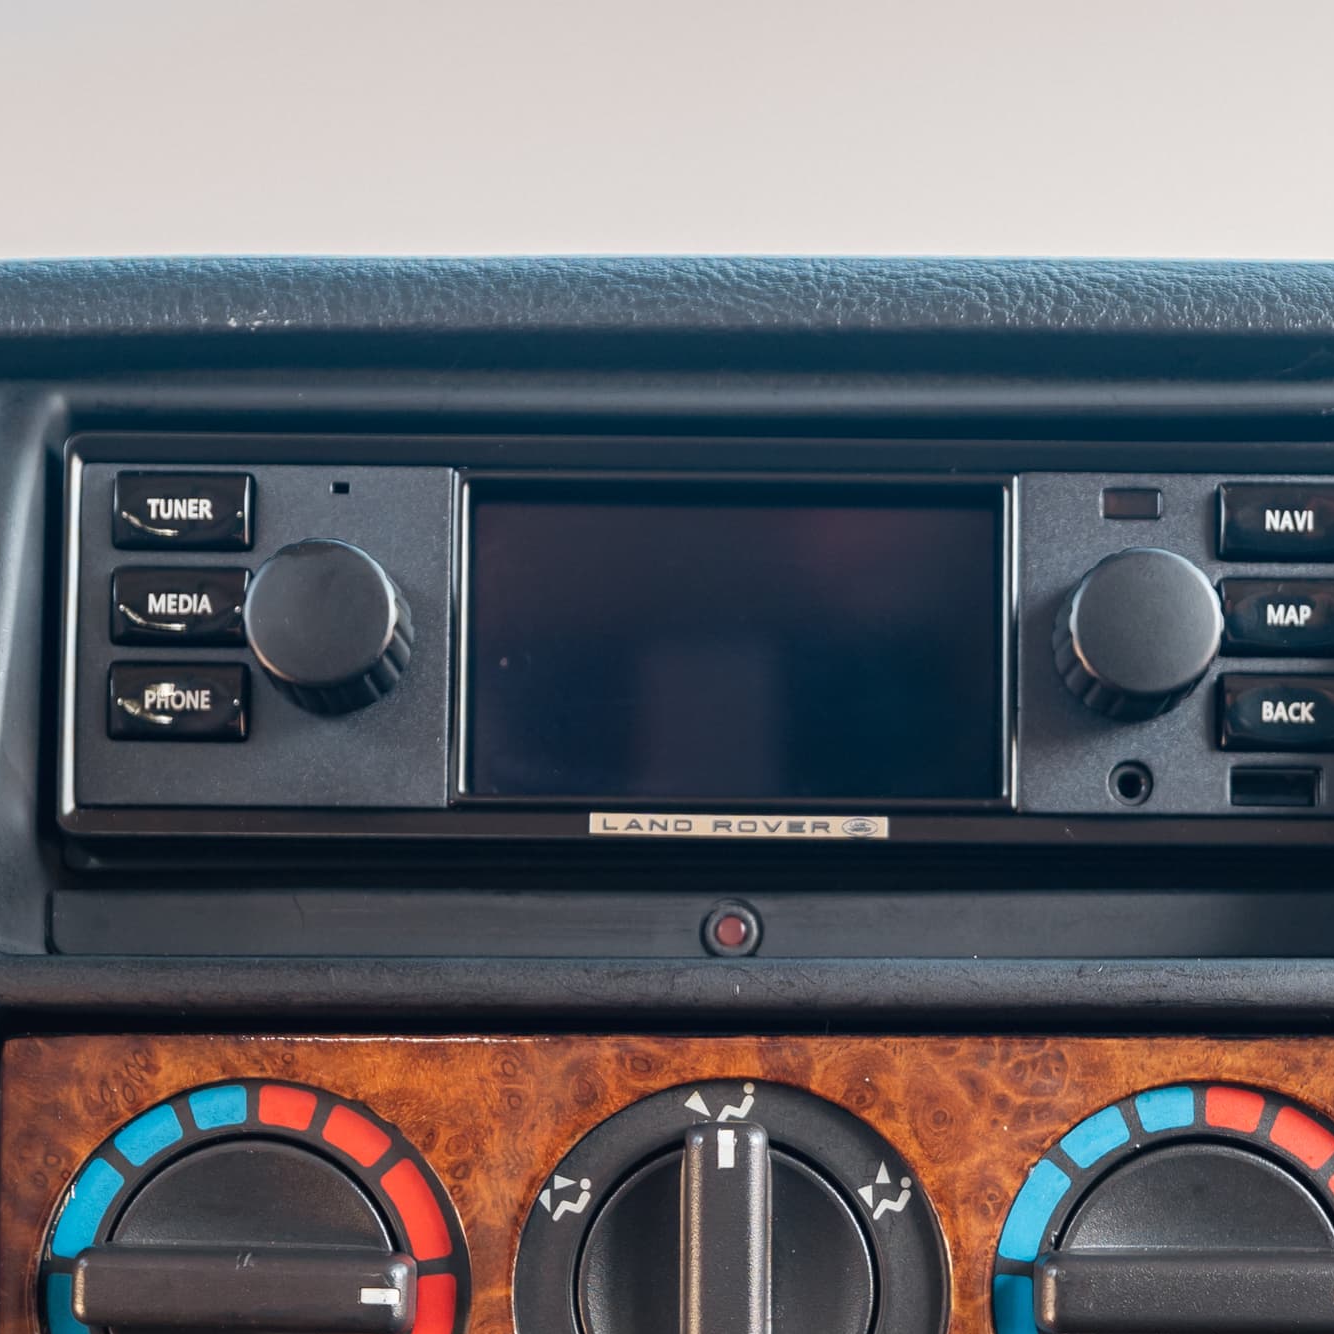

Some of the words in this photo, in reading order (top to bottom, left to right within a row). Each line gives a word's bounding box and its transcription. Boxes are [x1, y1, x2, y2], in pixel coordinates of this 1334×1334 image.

[146, 498, 214, 520] TUNER
[1264, 510, 1314, 532] NAVI
[147, 593, 213, 615] MEDIA
[1266, 604, 1312, 626] MAP
[144, 689, 211, 711] PHONE
[1261, 701, 1315, 723] BACK
[602, 818, 693, 832] LAND
[712, 820, 831, 833] ROVER
